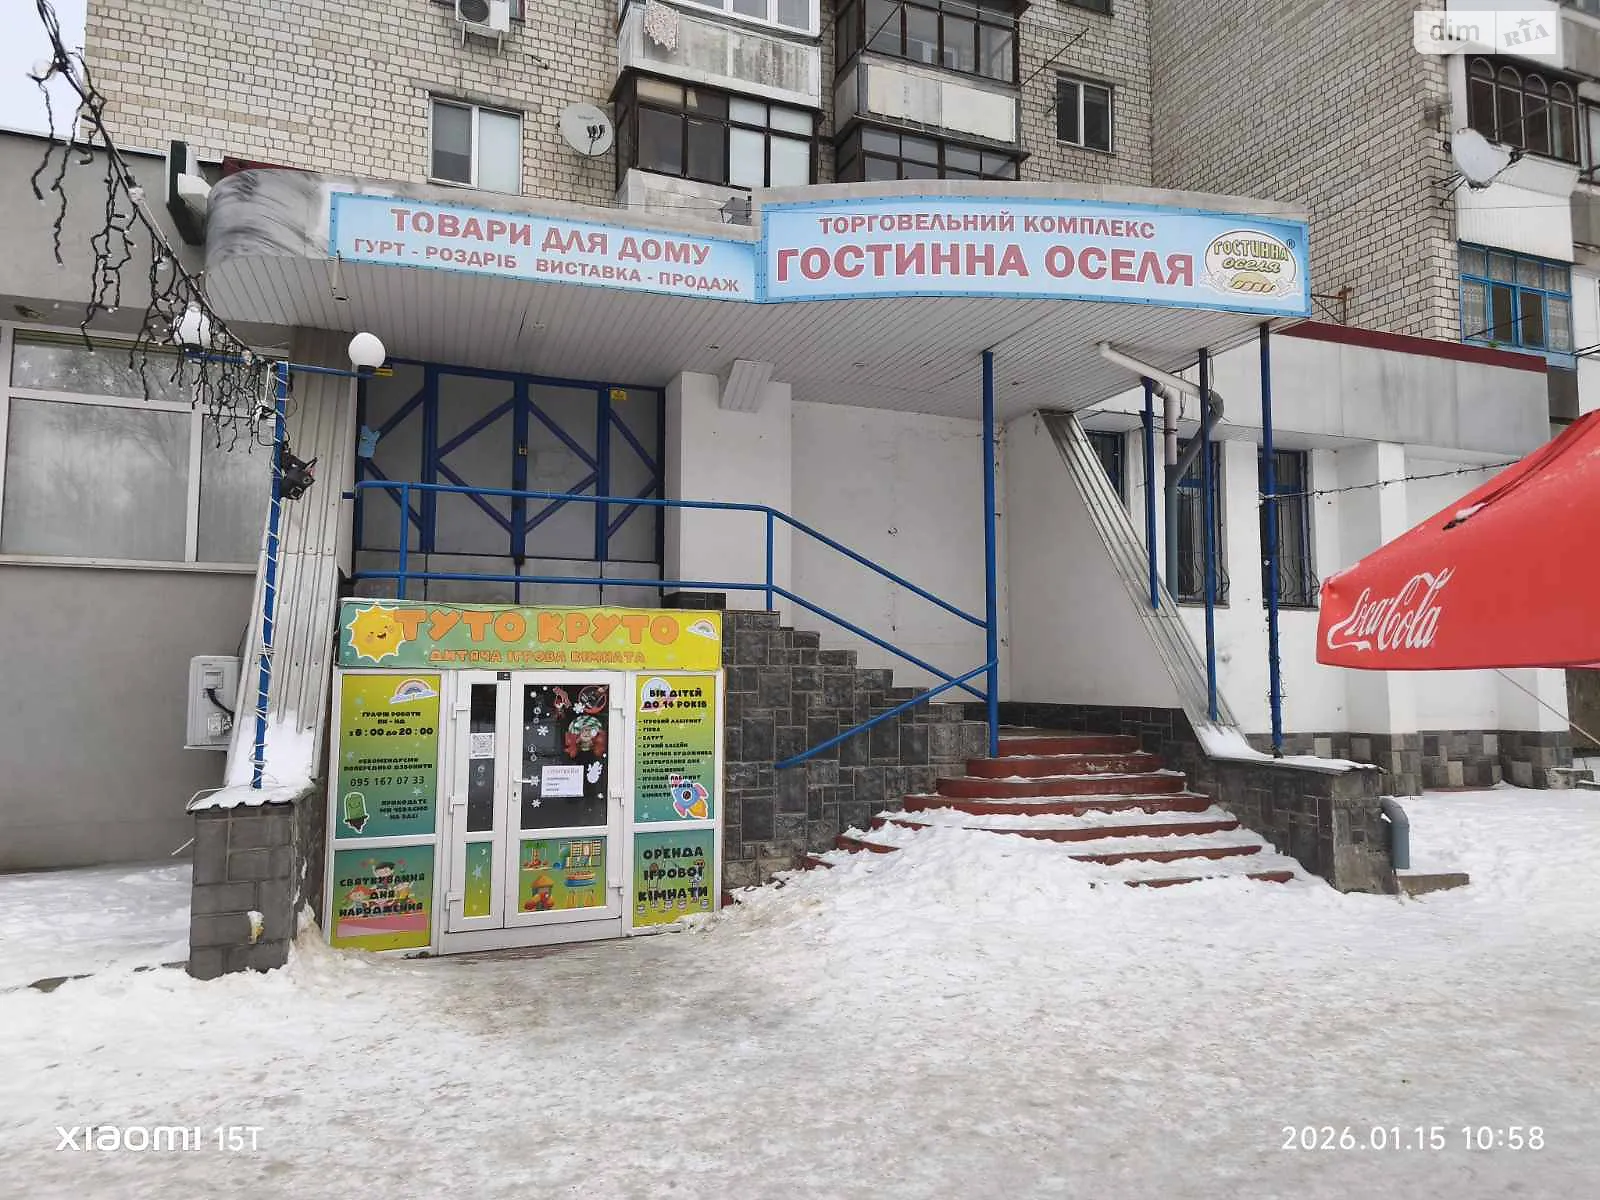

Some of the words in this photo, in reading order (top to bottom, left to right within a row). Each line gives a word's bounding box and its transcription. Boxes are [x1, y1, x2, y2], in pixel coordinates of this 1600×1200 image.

[390, 208, 531, 246] ТОВАРИ
[541, 227, 608, 255] ДЛЯ
[618, 236, 710, 265] ДОМУ
[819, 211, 1015, 234] ТОРГОВЕЛЬНИЙ
[1024, 215, 1155, 239] КОМПЛЕКС
[777, 242, 1029, 281] ГОСТИННА
[1045, 245, 1193, 286] ОСЕЛЯ
[1213, 239, 1289, 261] ГОСТИННА
[354, 238, 405, 257] ГУРТ
[426, 246, 517, 269] РОЗДРІБ
[536, 258, 641, 282] ВИСТАВКА
[659, 272, 740, 292] ПРОДАЖ
[394, 609, 527, 642] ТУТО
[537, 611, 680, 645] КРУТО
[644, 700, 660, 709] ДО
[677, 700, 707, 709] РОКІВ
[669, 687, 702, 698] ДІТЕЙ
[643, 846, 704, 860] ОРЕНДА
